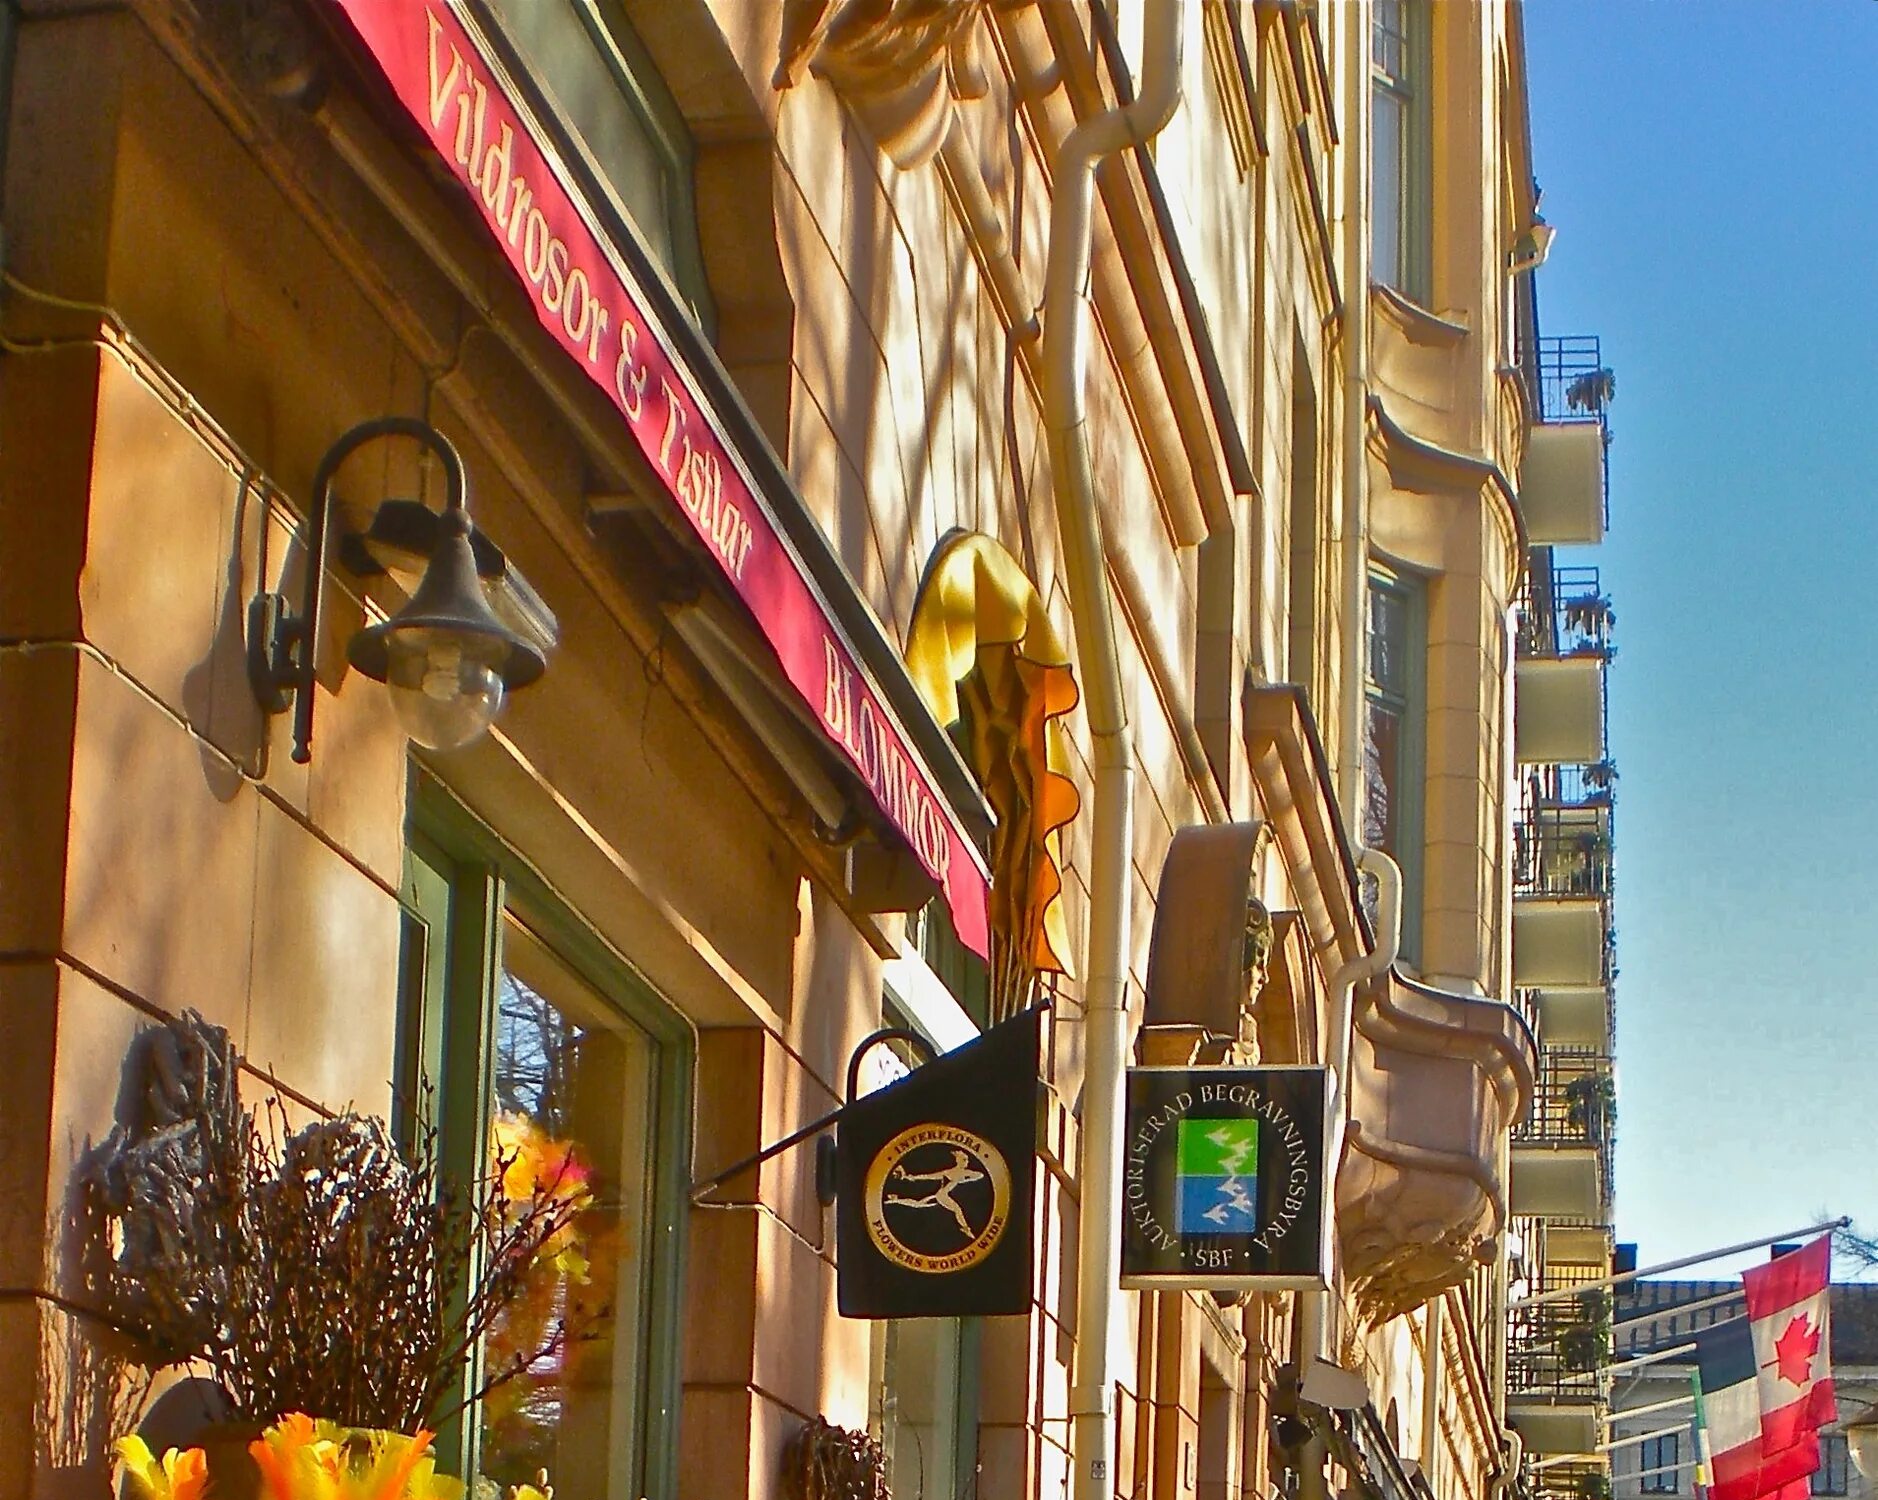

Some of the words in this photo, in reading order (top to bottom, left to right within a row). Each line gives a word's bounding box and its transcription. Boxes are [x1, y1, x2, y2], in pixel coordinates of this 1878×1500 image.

[425, 4, 609, 363] Vildrosor
[615, 319, 648, 423] &
[659, 375, 753, 581] Tistlar
[822, 634, 951, 900] BLOMMOR
[893, 1129, 982, 1155] INTERFLORA
[1127, 1091, 1193, 1251] AUKTORISERAD
[872, 1218, 924, 1268] FLOWERS
[926, 1250, 977, 1270] WORLD
[977, 1214, 1004, 1250] WIDE
[1195, 1248, 1234, 1268] SBF
